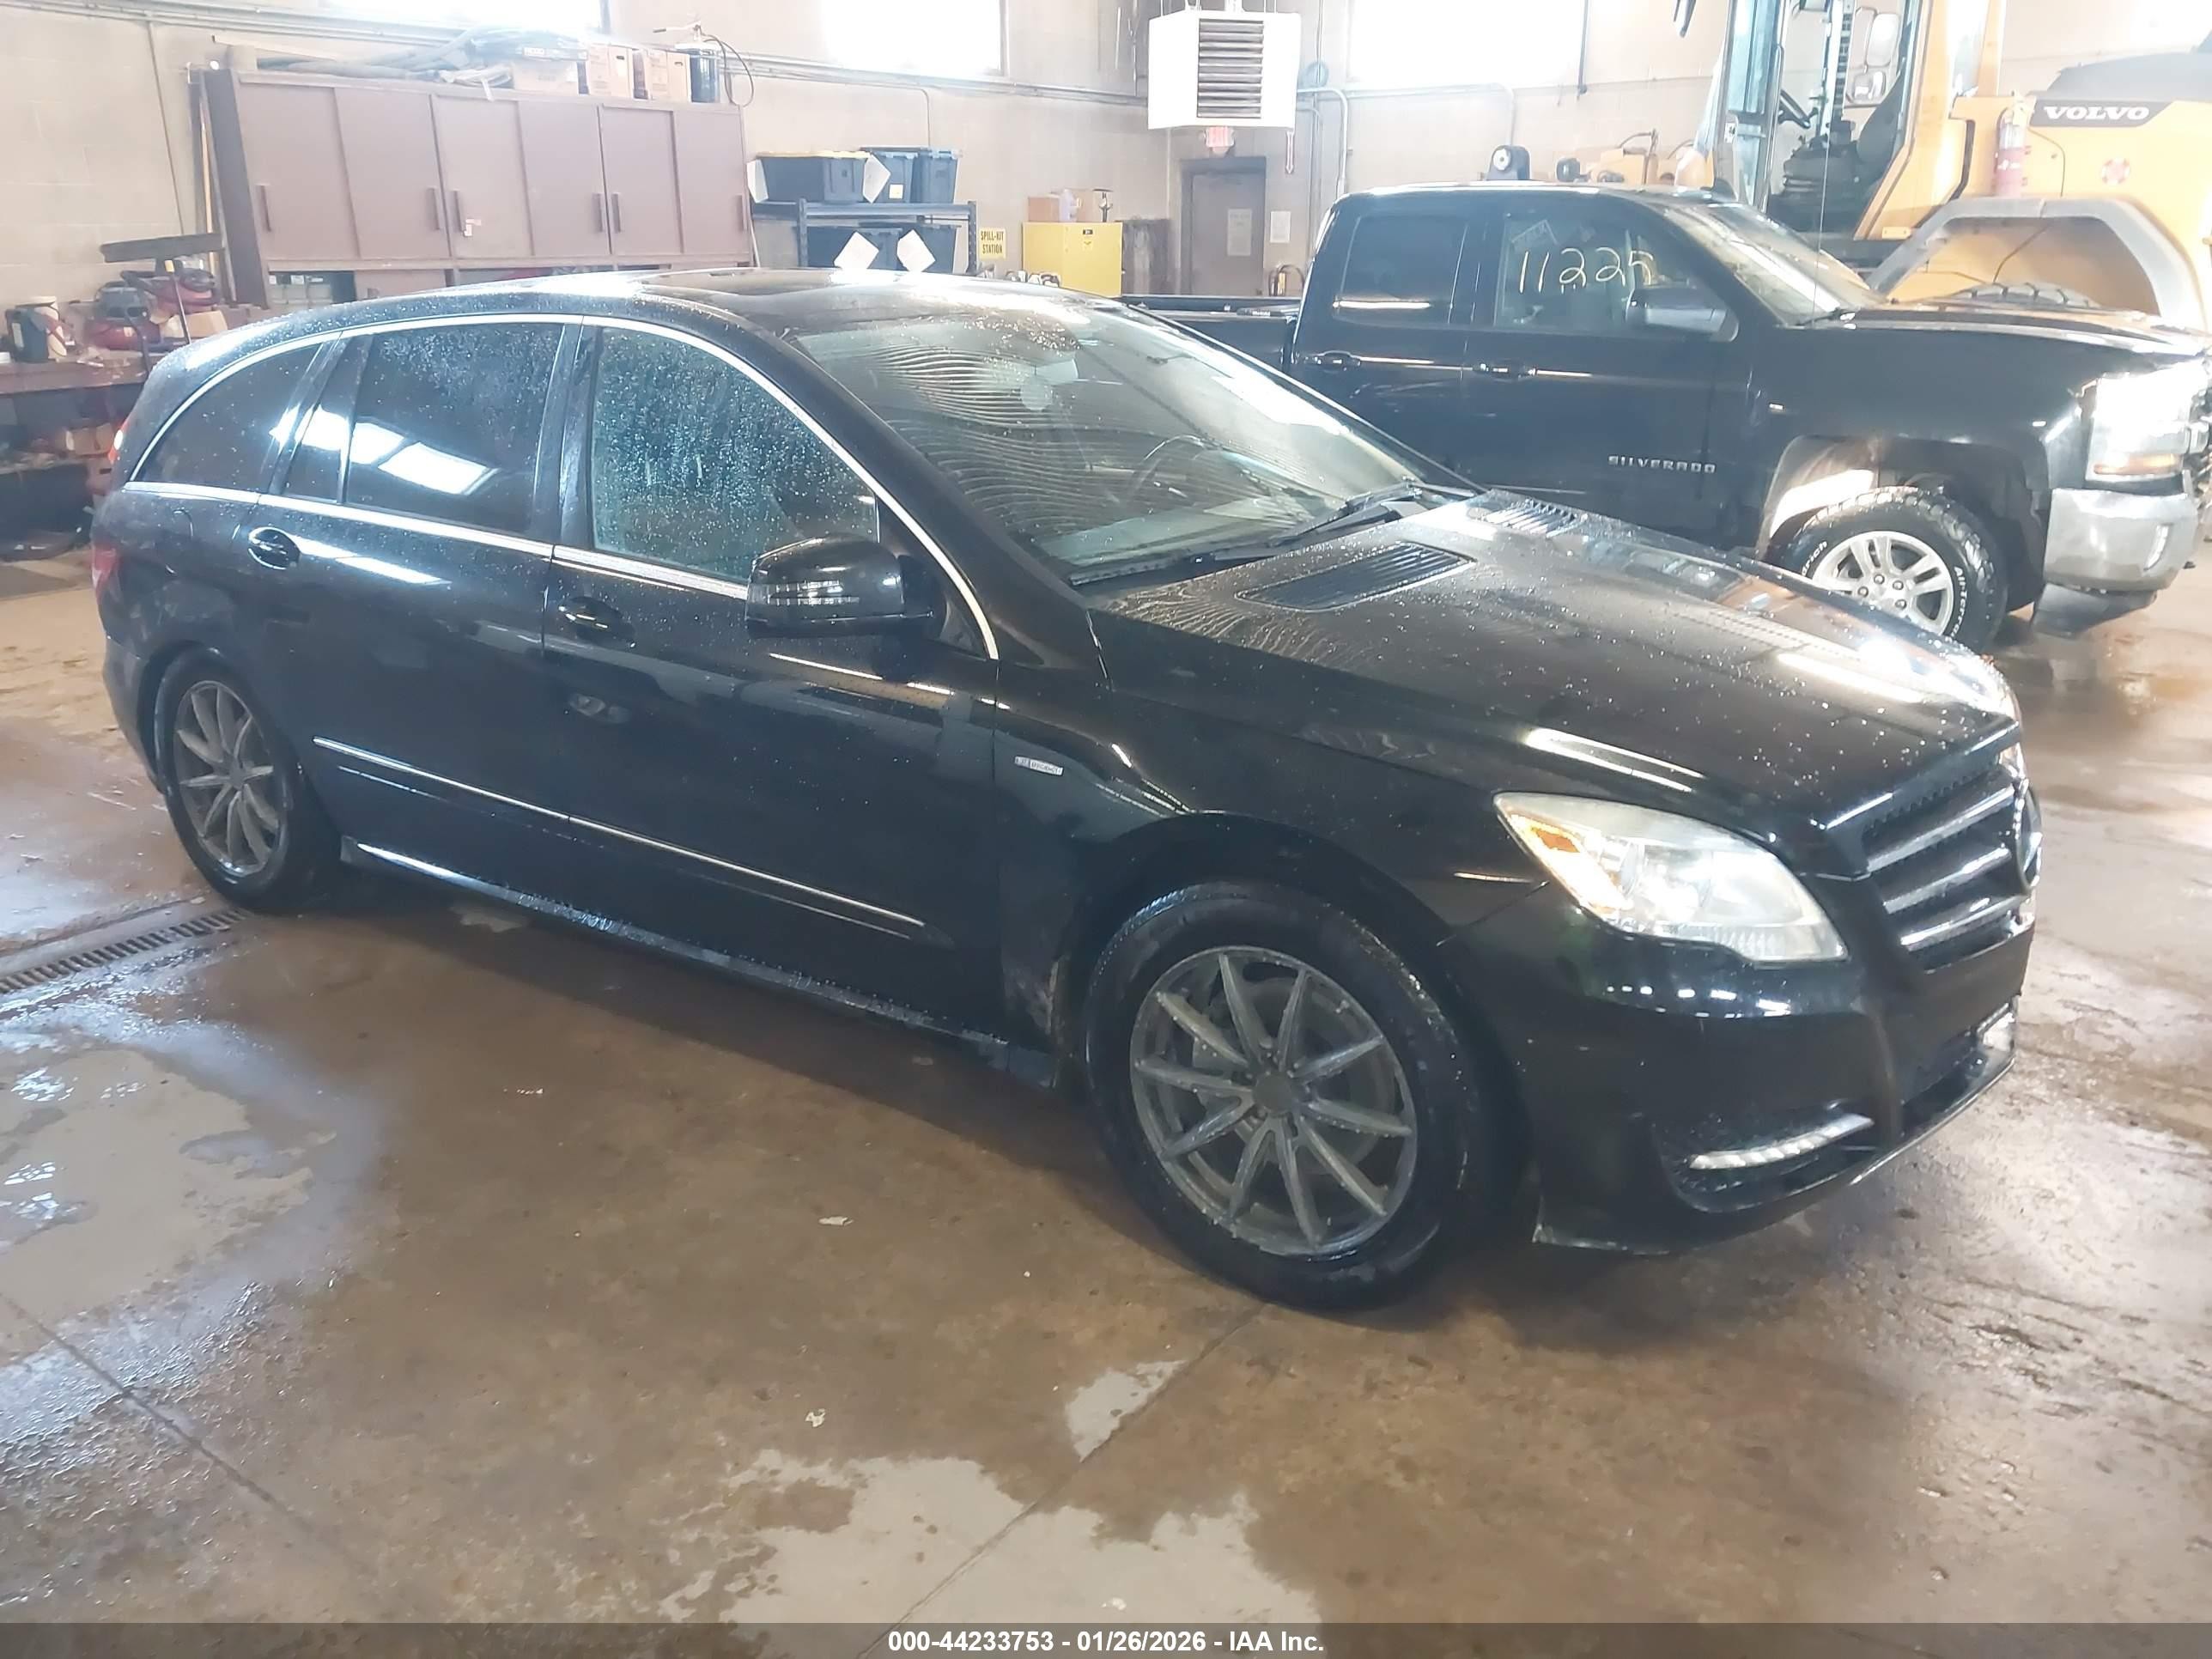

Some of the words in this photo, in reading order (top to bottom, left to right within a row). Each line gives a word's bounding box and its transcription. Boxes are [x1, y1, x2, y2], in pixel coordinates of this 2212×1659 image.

[2044, 106, 2150, 120] VOLVO
[981, 244, 1003, 254] STATION
[1519, 246, 1654, 295] 11225
[1802, 541, 1827, 576] drich
